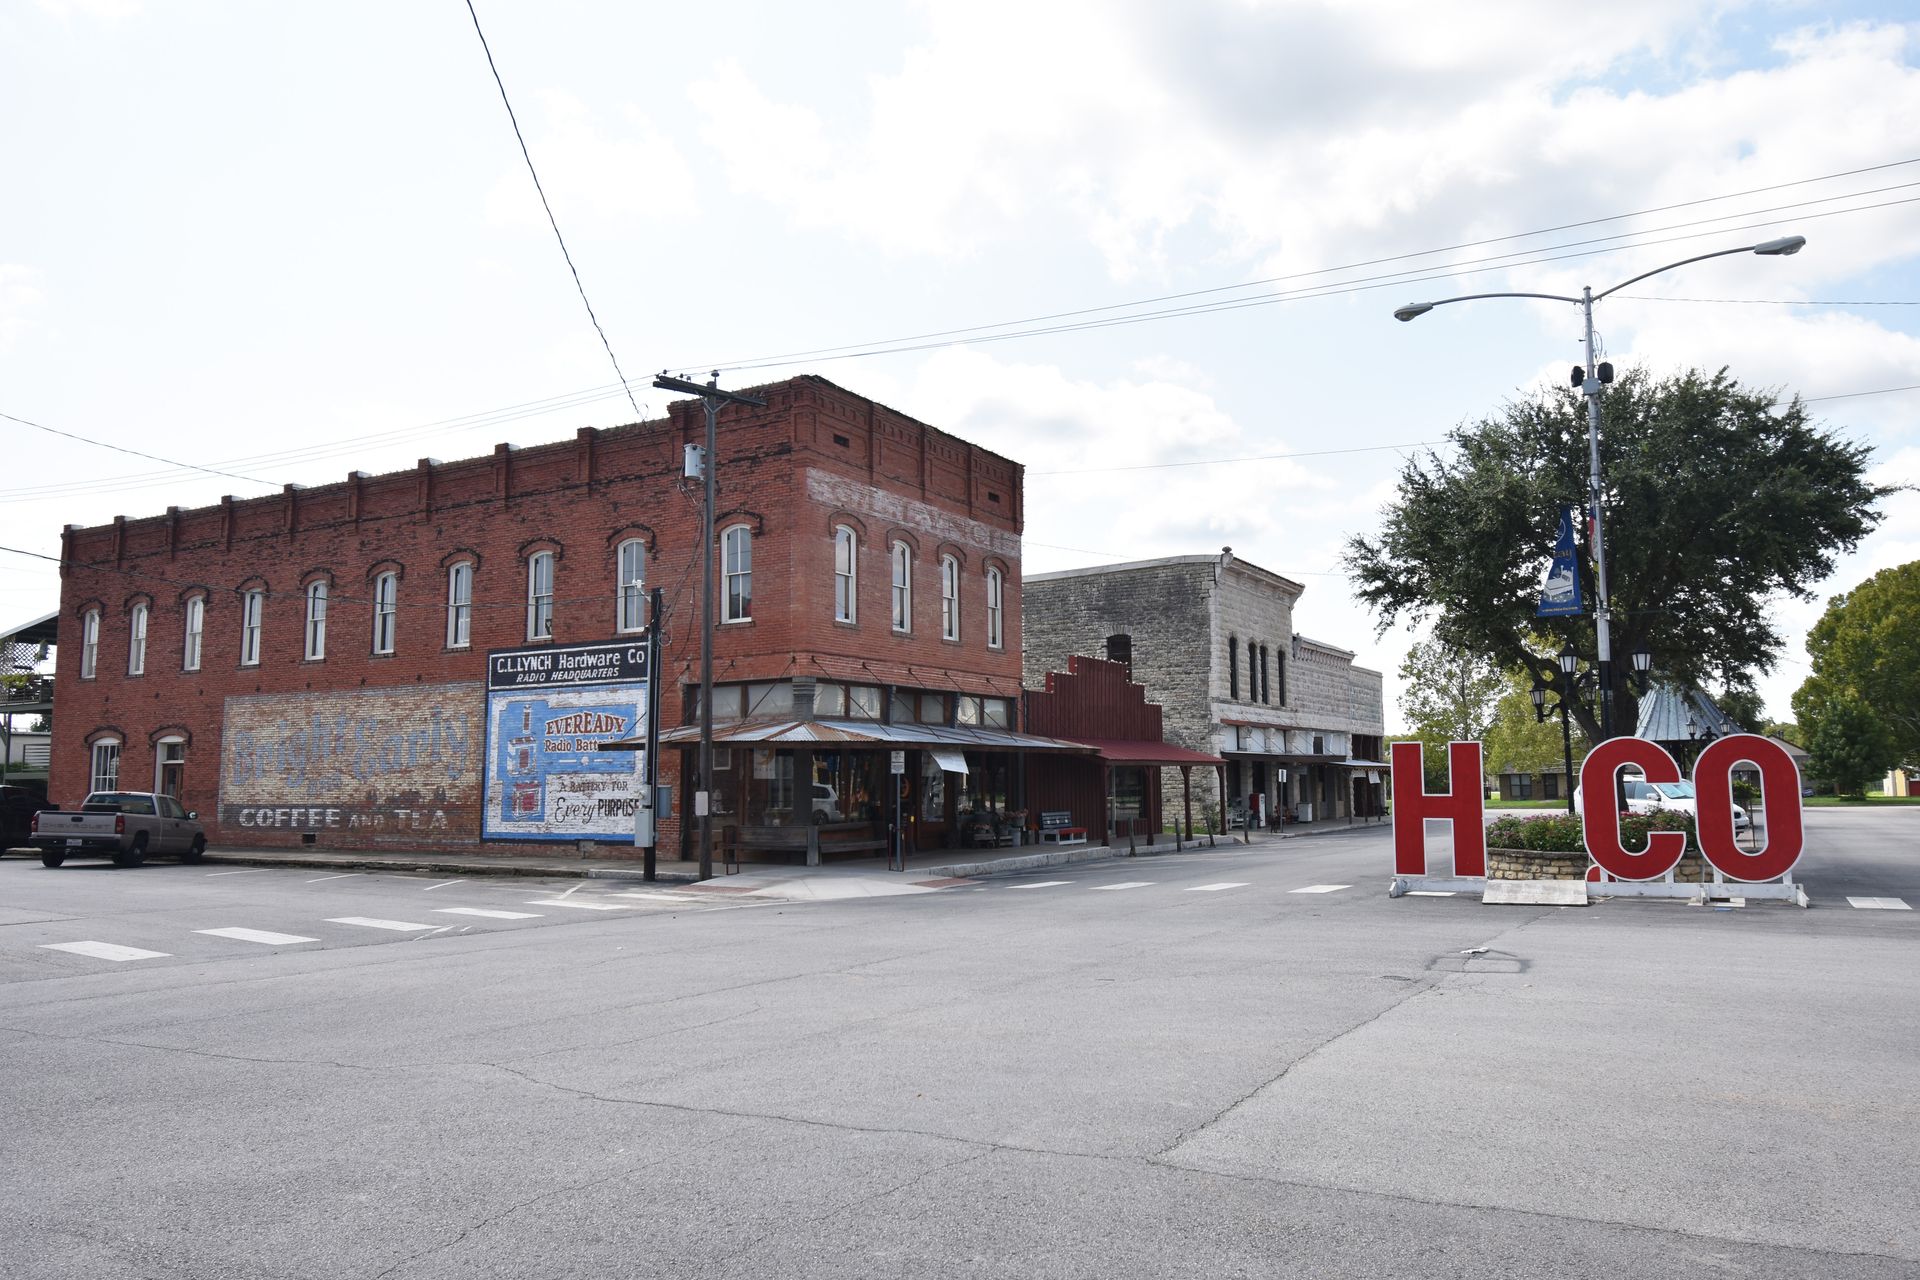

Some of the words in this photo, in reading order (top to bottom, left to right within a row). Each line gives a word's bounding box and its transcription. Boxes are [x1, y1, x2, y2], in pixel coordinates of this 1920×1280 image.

[559, 651, 620, 669] Hardware
[628, 649, 645, 664] Co
[516, 672, 546, 683] RADIO
[550, 667, 620, 682] HEADQUARTERS
[545, 712, 627, 736] EVEREADY
[233, 711, 350, 788] Bright
[353, 704, 469, 781] Early
[544, 738, 572, 753] Radio
[569, 781, 608, 792] BATTERY
[611, 780, 629, 791] FOR
[239, 808, 341, 828] COFFEE
[348, 814, 384, 829] AND
[394, 809, 449, 830] TEA
[554, 796, 597, 824] Every
